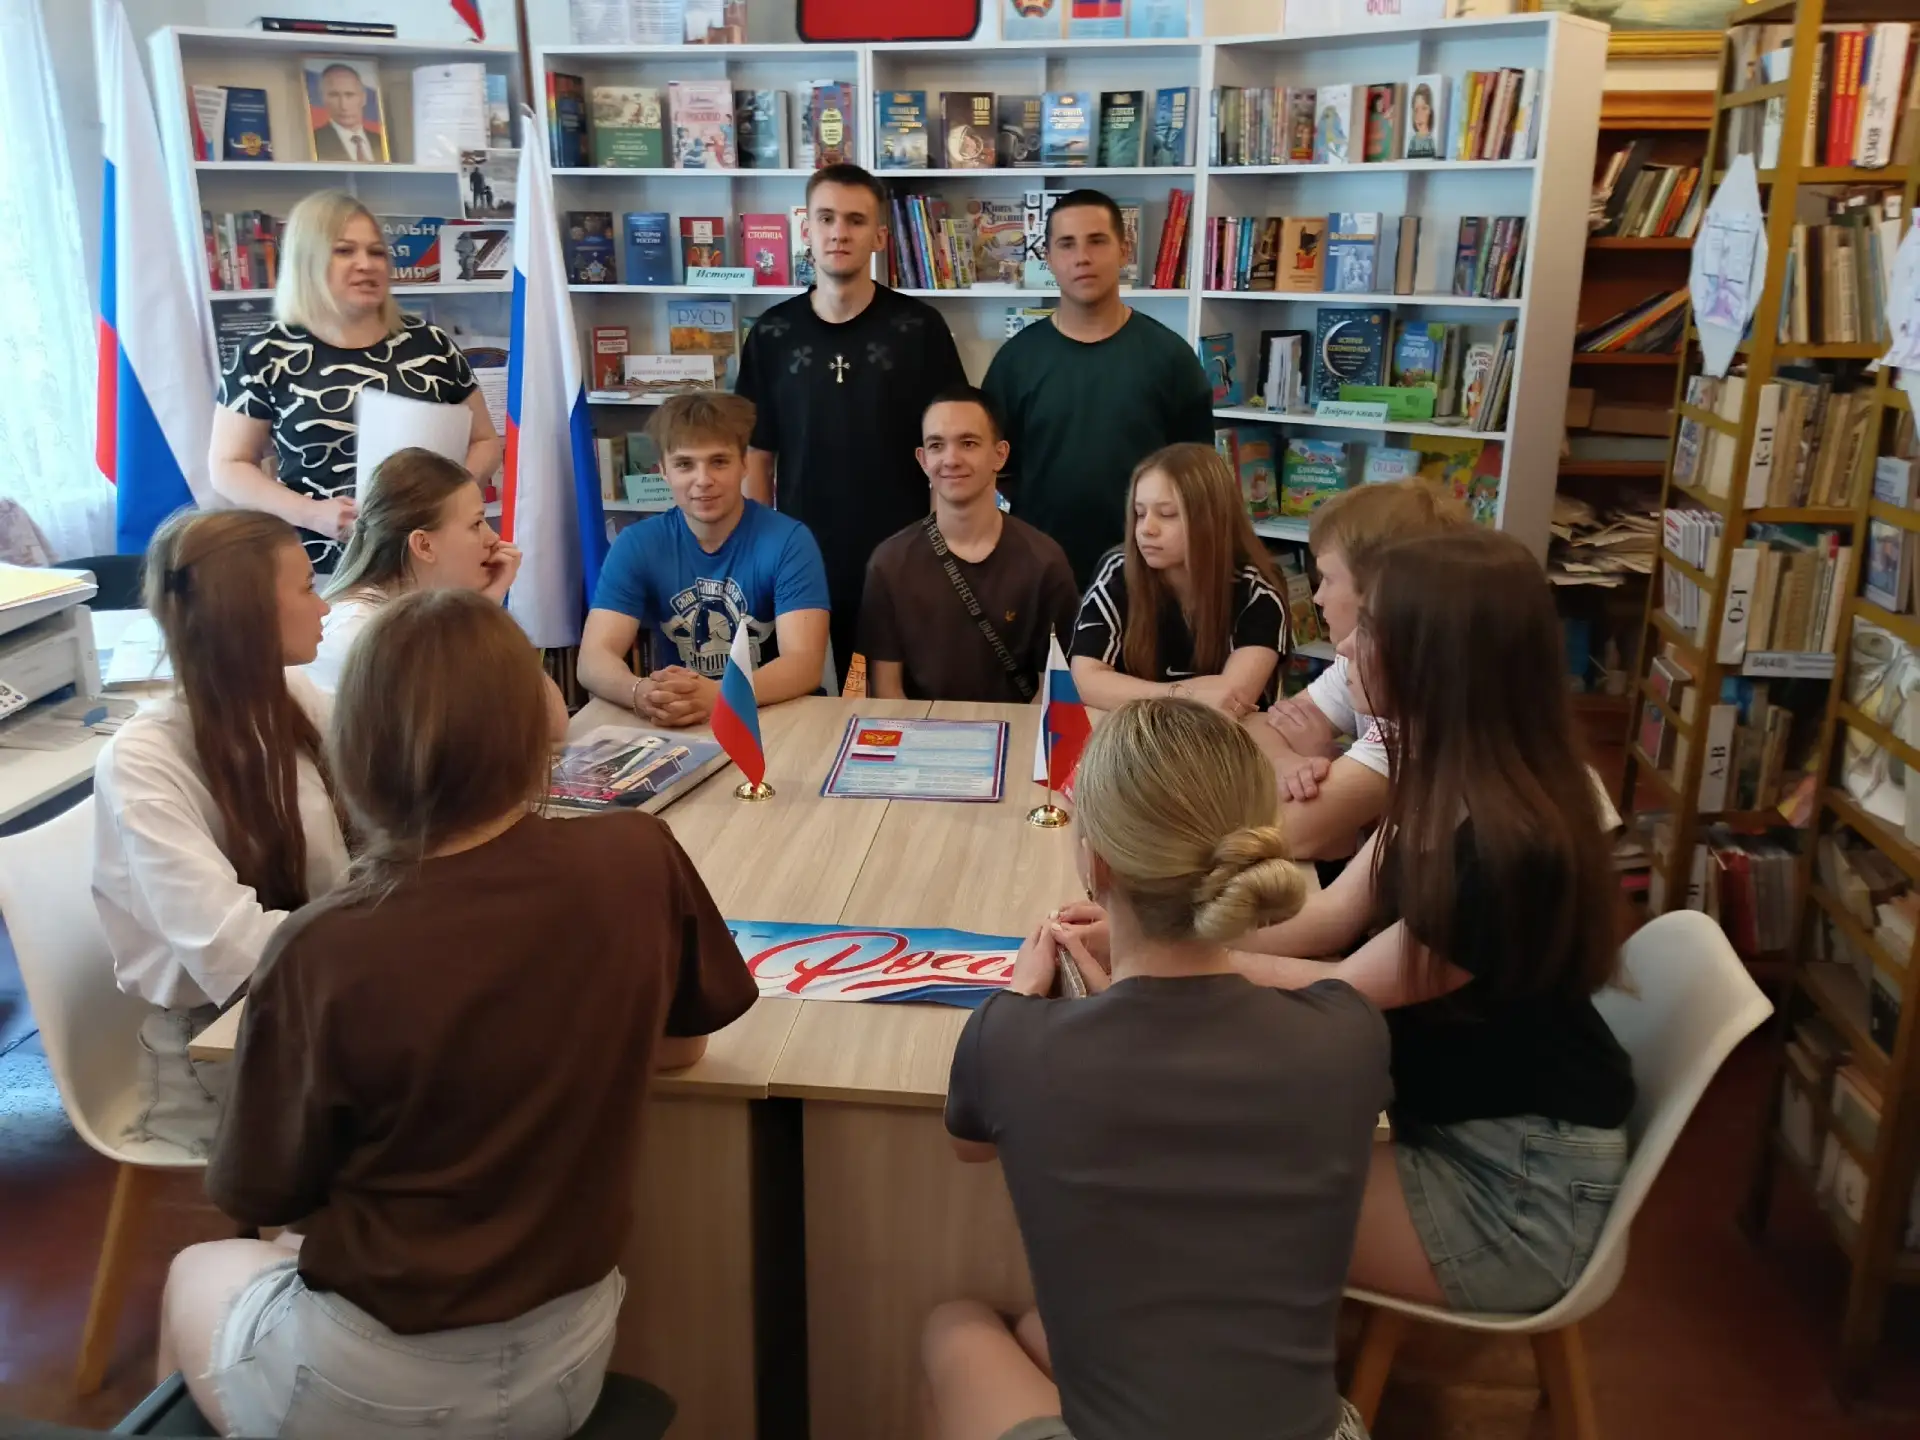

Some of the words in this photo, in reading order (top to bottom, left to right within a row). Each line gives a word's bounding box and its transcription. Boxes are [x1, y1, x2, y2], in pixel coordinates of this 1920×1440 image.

[384, 224, 436, 235] АЛЬН
[388, 245, 411, 257] АЯ
[695, 269, 746, 280] История
[677, 308, 726, 326] РУСЬ
[944, 559, 982, 616] UNAFFECTED
[1728, 586, 1748, 623] О-Т
[748, 930, 1013, 994] Росс
